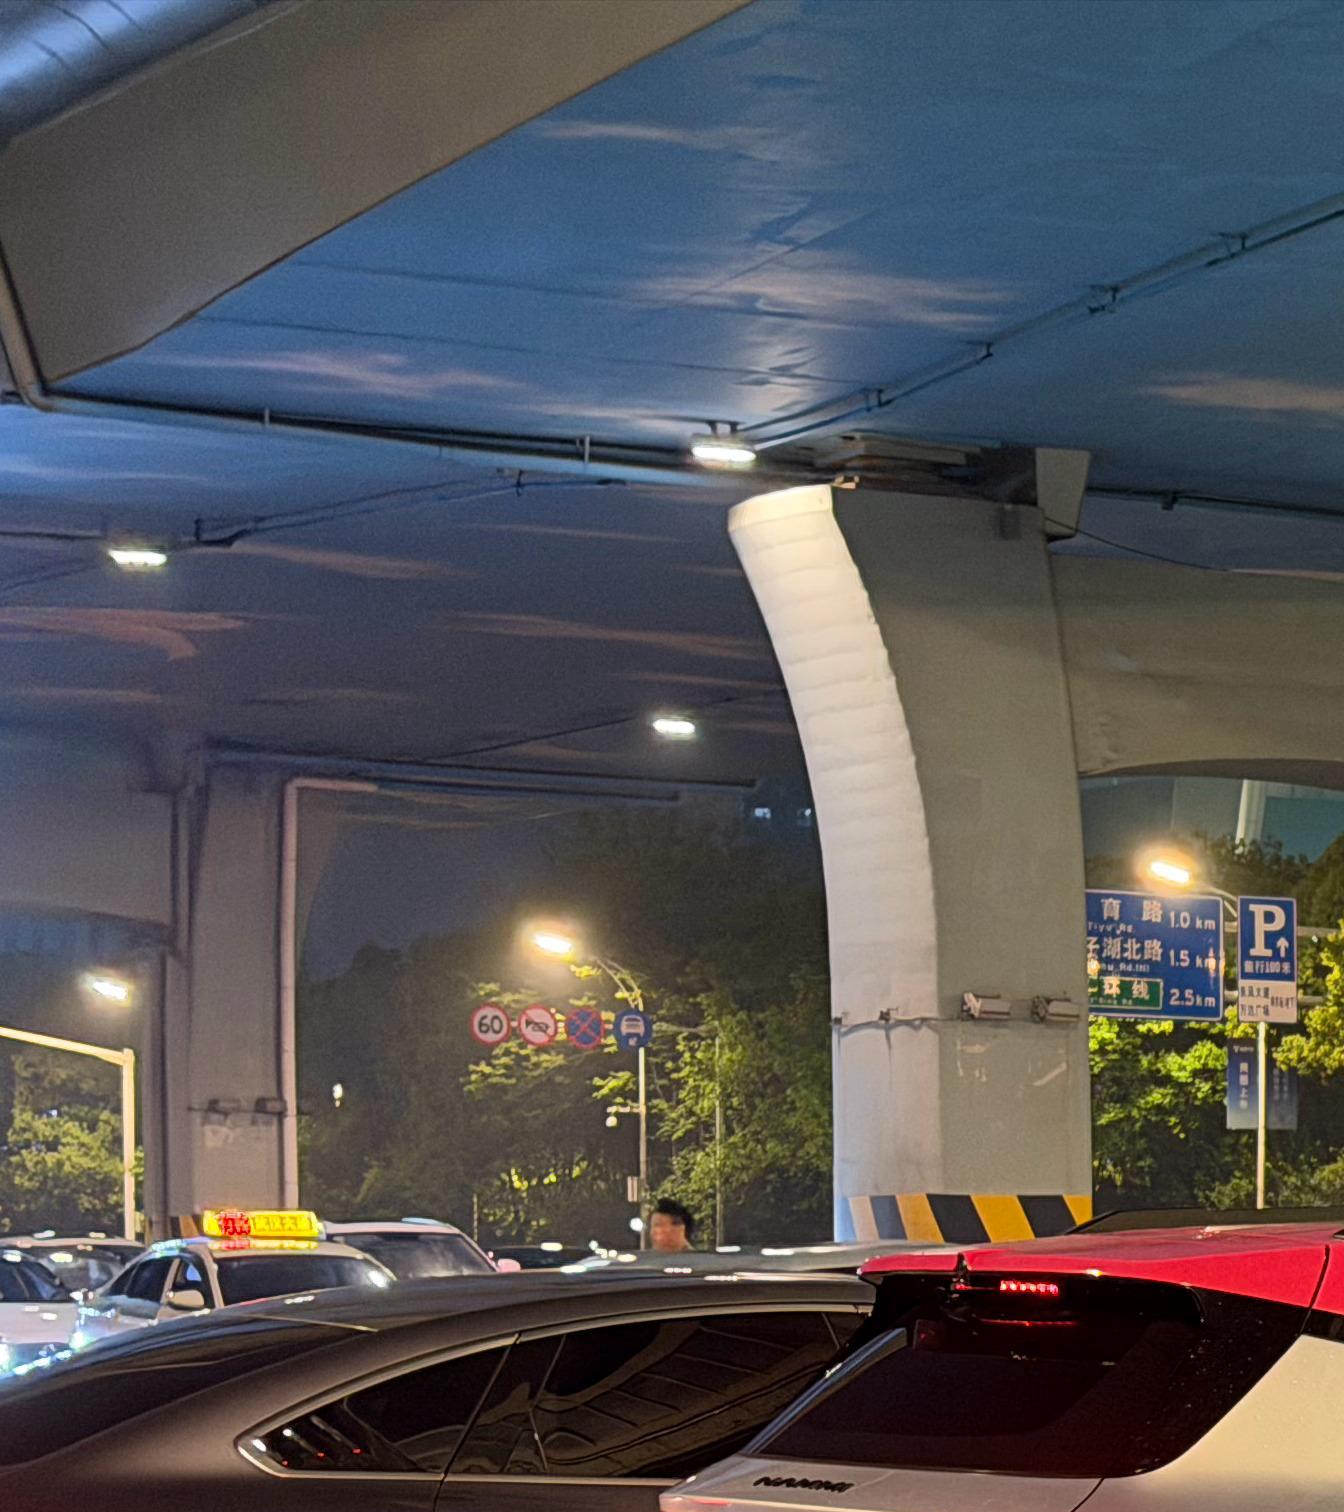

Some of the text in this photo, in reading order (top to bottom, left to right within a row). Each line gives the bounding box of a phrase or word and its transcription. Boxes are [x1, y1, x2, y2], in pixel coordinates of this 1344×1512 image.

[1169, 911, 1216, 930] 1.0 km
[1249, 904, 1286, 957] P
[1169, 948, 1190, 968] 1.5
[478, 1015, 503, 1034] 60
